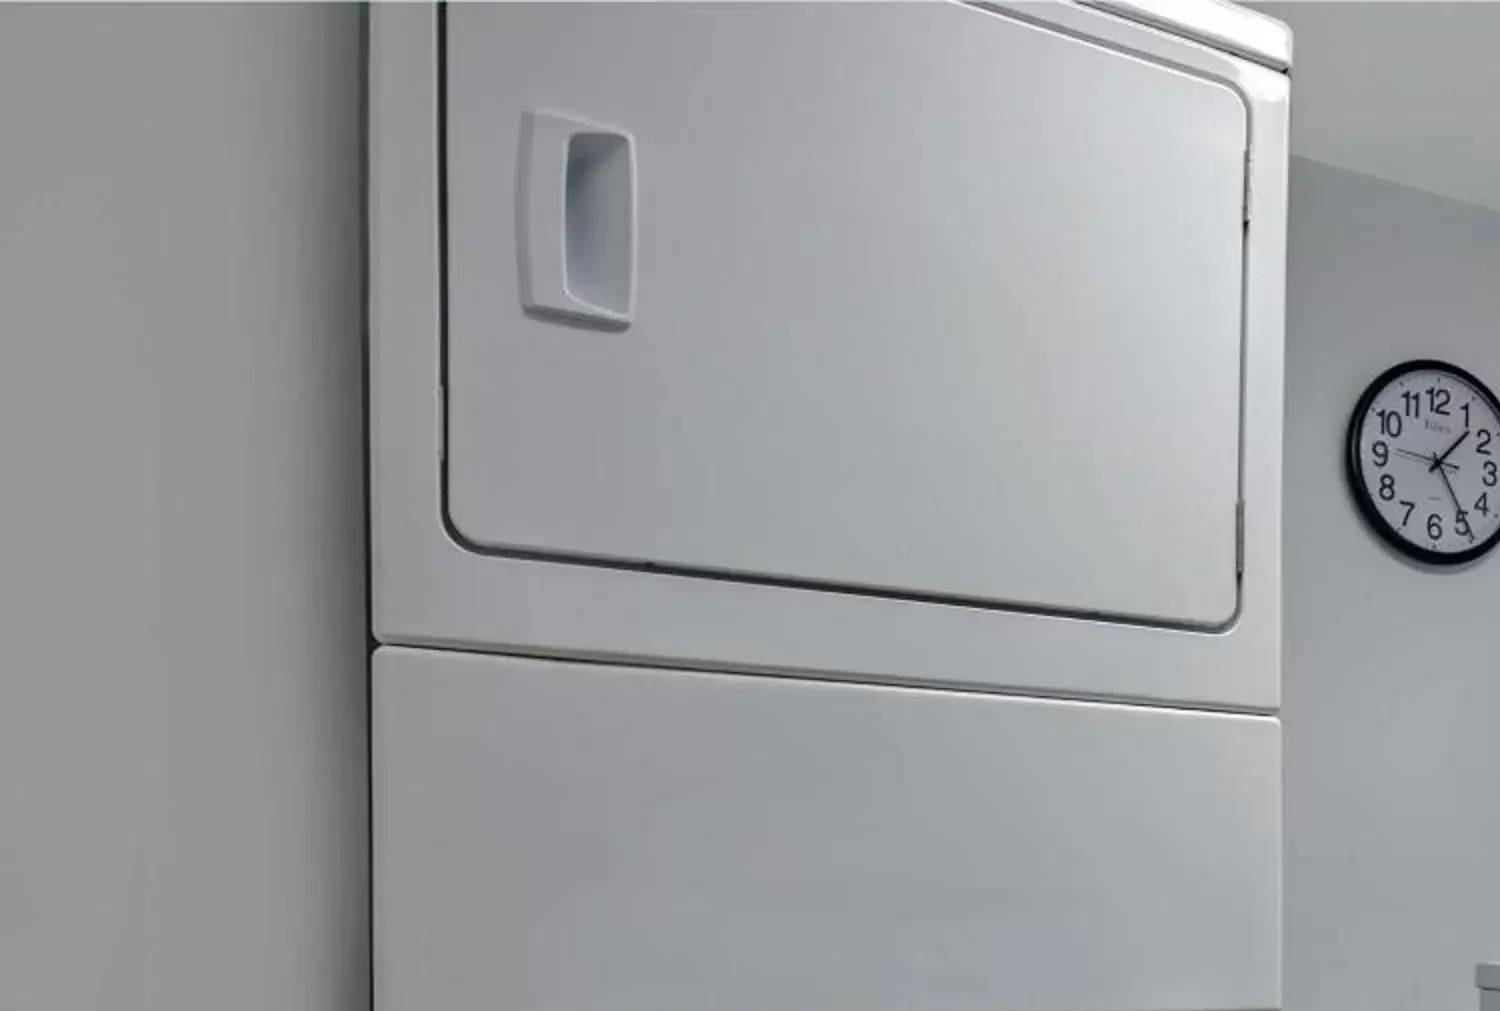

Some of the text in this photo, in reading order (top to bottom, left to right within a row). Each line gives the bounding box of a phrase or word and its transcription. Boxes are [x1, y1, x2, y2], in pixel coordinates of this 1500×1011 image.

[1401, 391, 1421, 418] 11
[1425, 387, 1451, 416] 12
[1376, 409, 1403, 438] 10
[1460, 403, 1470, 428] 1
[1371, 440, 1389, 468] 9
[1475, 429, 1492, 456] 2
[1378, 474, 1396, 501] 8
[1481, 461, 1498, 487] 3
[1399, 500, 1416, 527] 7
[1473, 492, 1489, 518] 4
[1426, 513, 1443, 541] 6
[1454, 510, 1470, 536] 5
